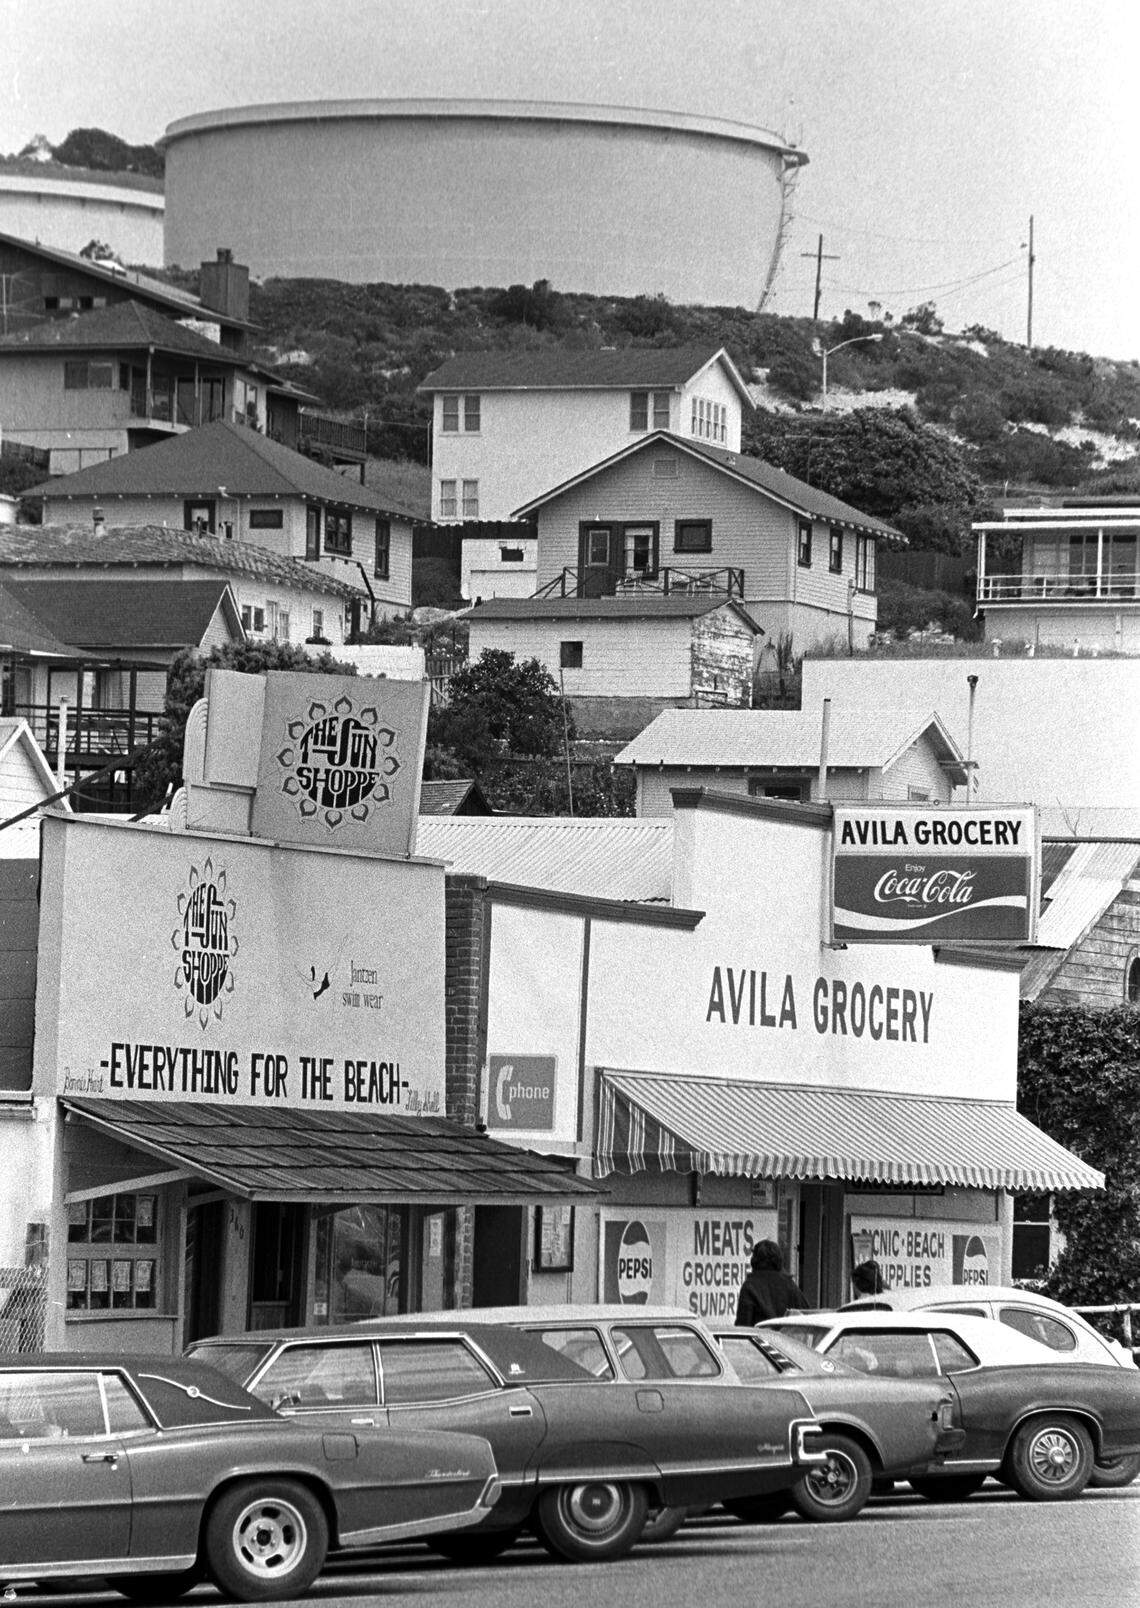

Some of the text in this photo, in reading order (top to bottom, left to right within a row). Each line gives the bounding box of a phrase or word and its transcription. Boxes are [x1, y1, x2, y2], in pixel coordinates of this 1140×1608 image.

[300, 716, 378, 769] THE SUN
[296, 766, 380, 808] SHOPPE
[841, 820, 1022, 845] AVILA GROCERY
[905, 863, 926, 873] Enjoy
[873, 869, 978, 903] Coca-Cola
[183, 882, 228, 951] THE SUN
[182, 949, 230, 1005] SHOPPE
[705, 965, 934, 1044] AVILA GROCERY
[250, 1053, 288, 1098] FOR
[299, 1056, 334, 1101] THE
[509, 1082, 551, 1103] phone
[694, 1219, 754, 1256] MEATS
[907, 1231, 945, 1258] BEACH
[618, 1258, 653, 1280] PEPSI
[880, 1264, 932, 1288] UPPLIES
[963, 1268, 989, 1286] PEPSI
[689, 1291, 736, 1317] SUNDR
